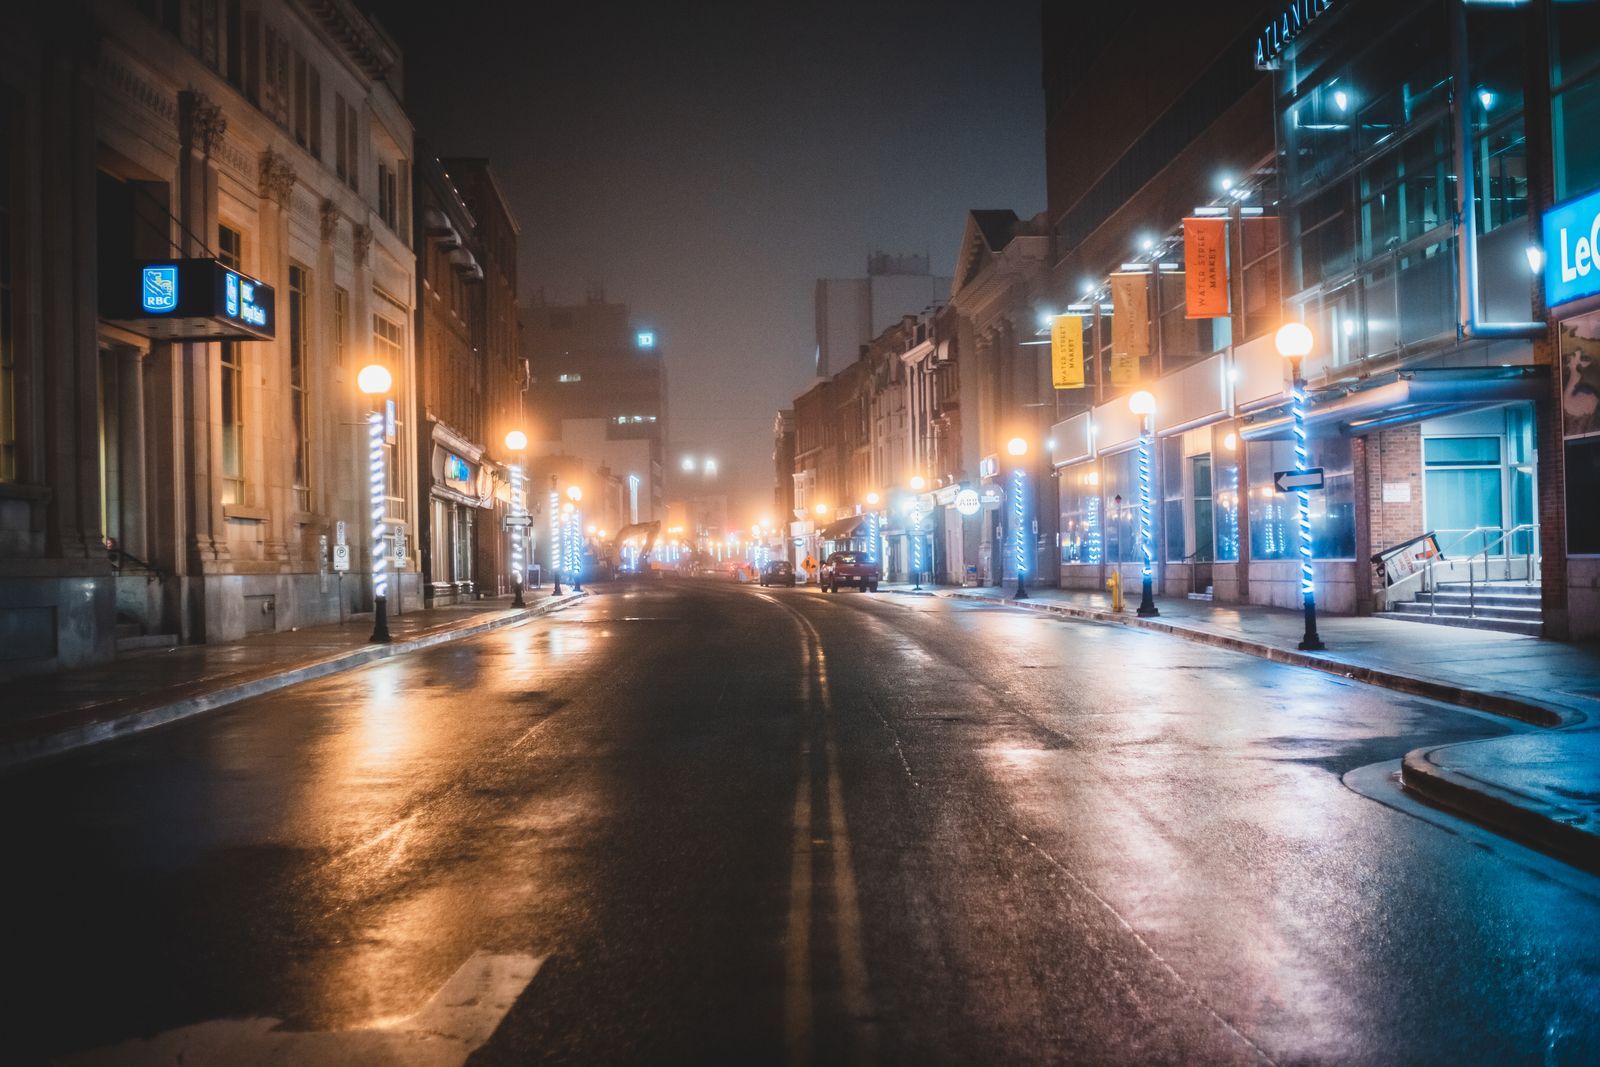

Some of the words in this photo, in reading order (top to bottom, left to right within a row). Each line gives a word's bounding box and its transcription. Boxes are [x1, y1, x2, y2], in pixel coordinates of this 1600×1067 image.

[1197, 229, 1206, 266] STREET
[1208, 247, 1217, 288] MARKET
[147, 296, 172, 306] RBC
[1197, 271, 1206, 307] WATER
